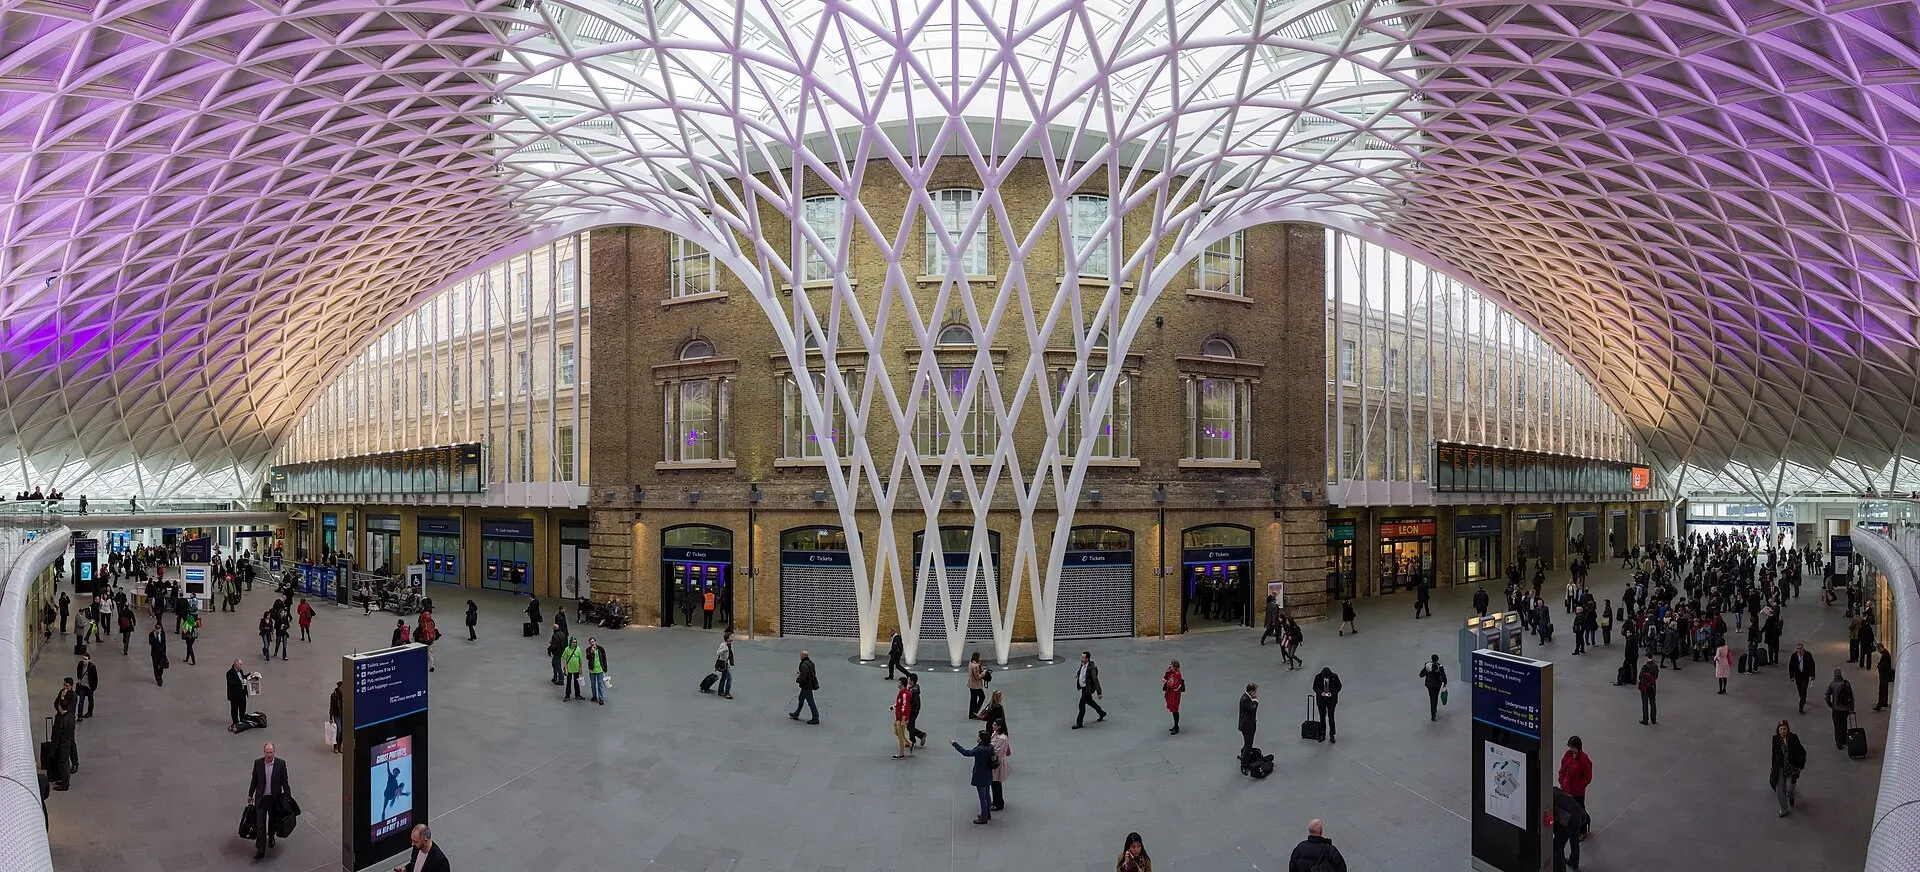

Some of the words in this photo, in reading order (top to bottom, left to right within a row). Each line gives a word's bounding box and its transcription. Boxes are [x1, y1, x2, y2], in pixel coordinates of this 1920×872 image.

[1399, 525, 1418, 534] LEON
[1505, 700, 1527, 711] Underground
[1500, 714, 1516, 723] Platforms
[376, 753, 388, 764] GHOST
